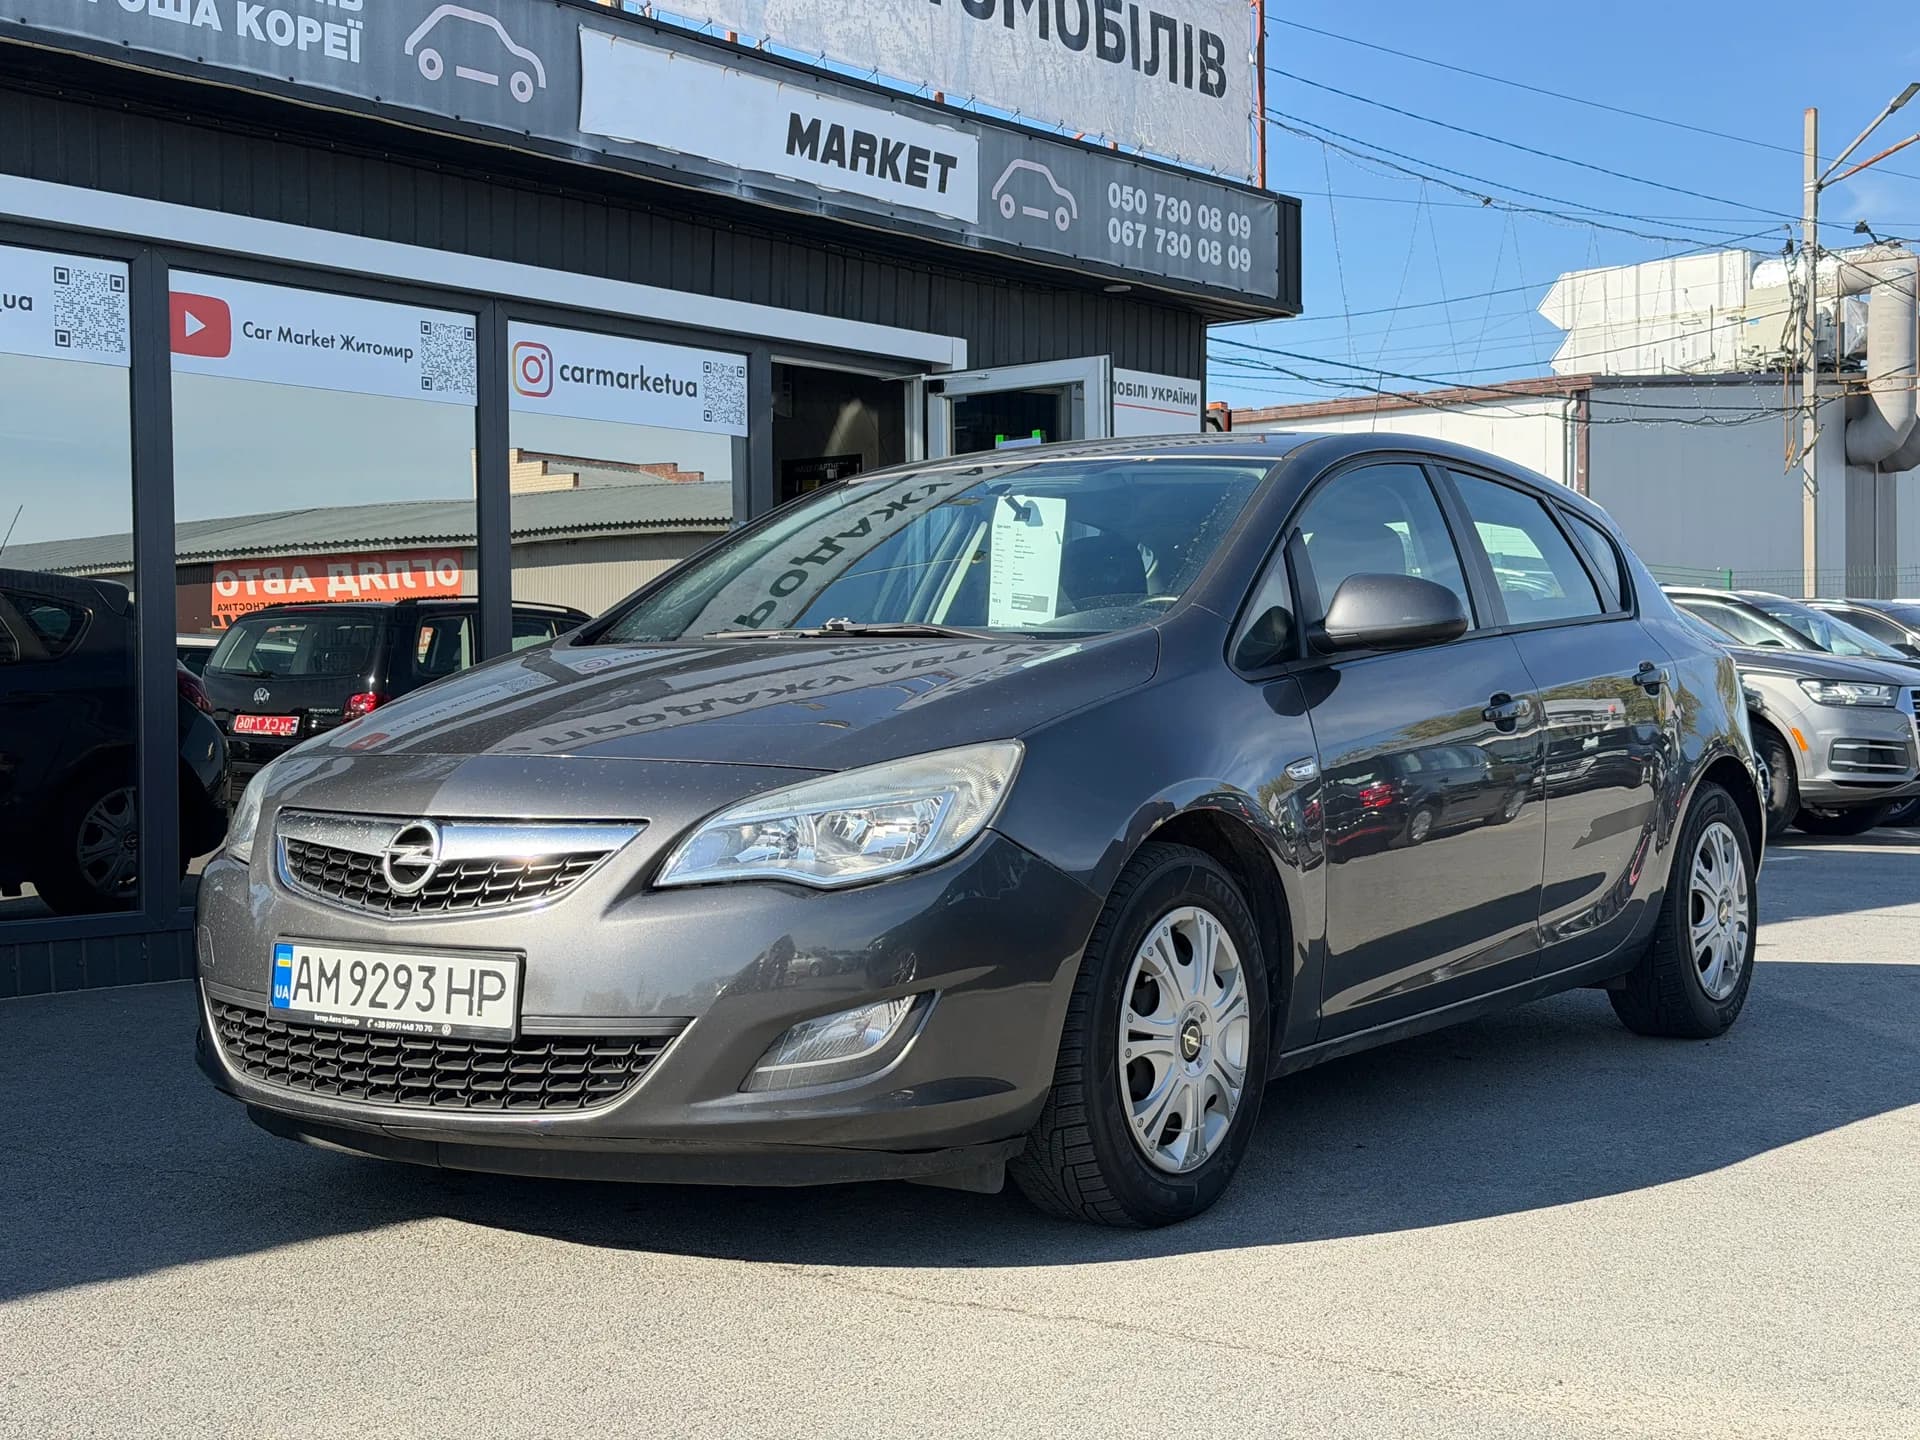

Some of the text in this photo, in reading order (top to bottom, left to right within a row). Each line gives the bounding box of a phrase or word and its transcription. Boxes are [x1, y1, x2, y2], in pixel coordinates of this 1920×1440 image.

[237, 2, 363, 63] КОРЕЇ
[786, 112, 958, 194] MARKET
[1108, 182, 1251, 240] 050 730 08 09
[1108, 217, 1251, 272] 067 730 08 09
[0, 293, 33, 312] ua
[242, 321, 413, 363] Car Market Житомир
[559, 364, 697, 397] carmarketua
[1151, 386, 1197, 406] УКРАЇНИ
[275, 984, 289, 999] UA
[350, 960, 437, 1013] 9293
